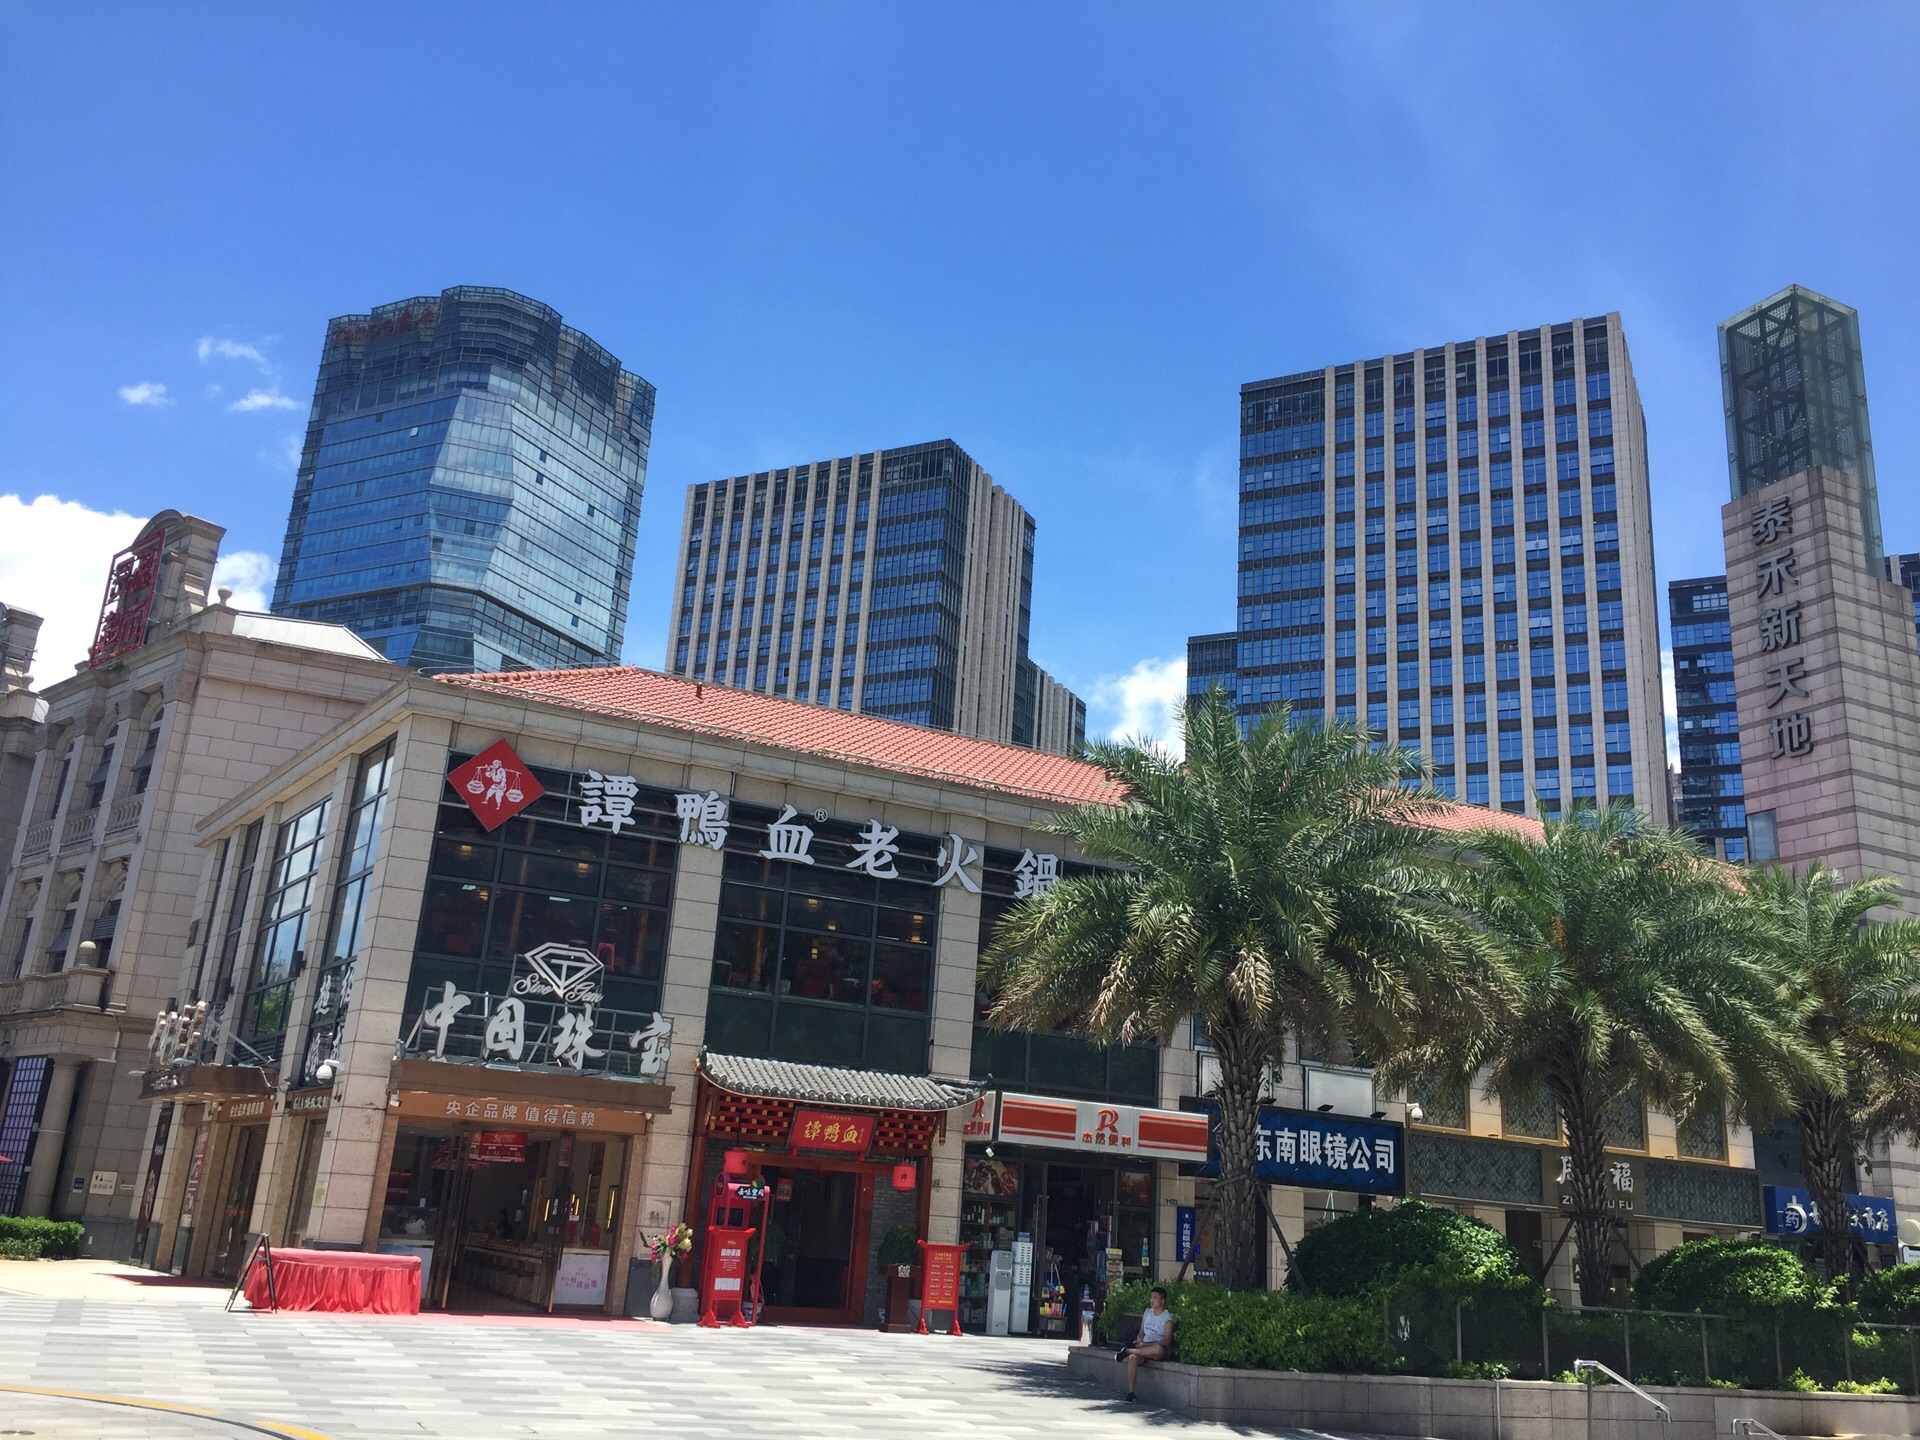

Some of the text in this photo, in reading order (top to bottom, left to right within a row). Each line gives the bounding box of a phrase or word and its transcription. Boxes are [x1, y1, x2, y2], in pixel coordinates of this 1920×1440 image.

[1752, 496, 1814, 760] 泰禾新天地
[424, 980, 672, 1074] 中国珠宝
[445, 1099, 595, 1127] 央企品牌 值得信赖
[1081, 1130, 1132, 1148] 杰然便利
[1255, 1124, 1394, 1174] 东南眼镜公司
[1784, 1209, 1800, 1229] 药
